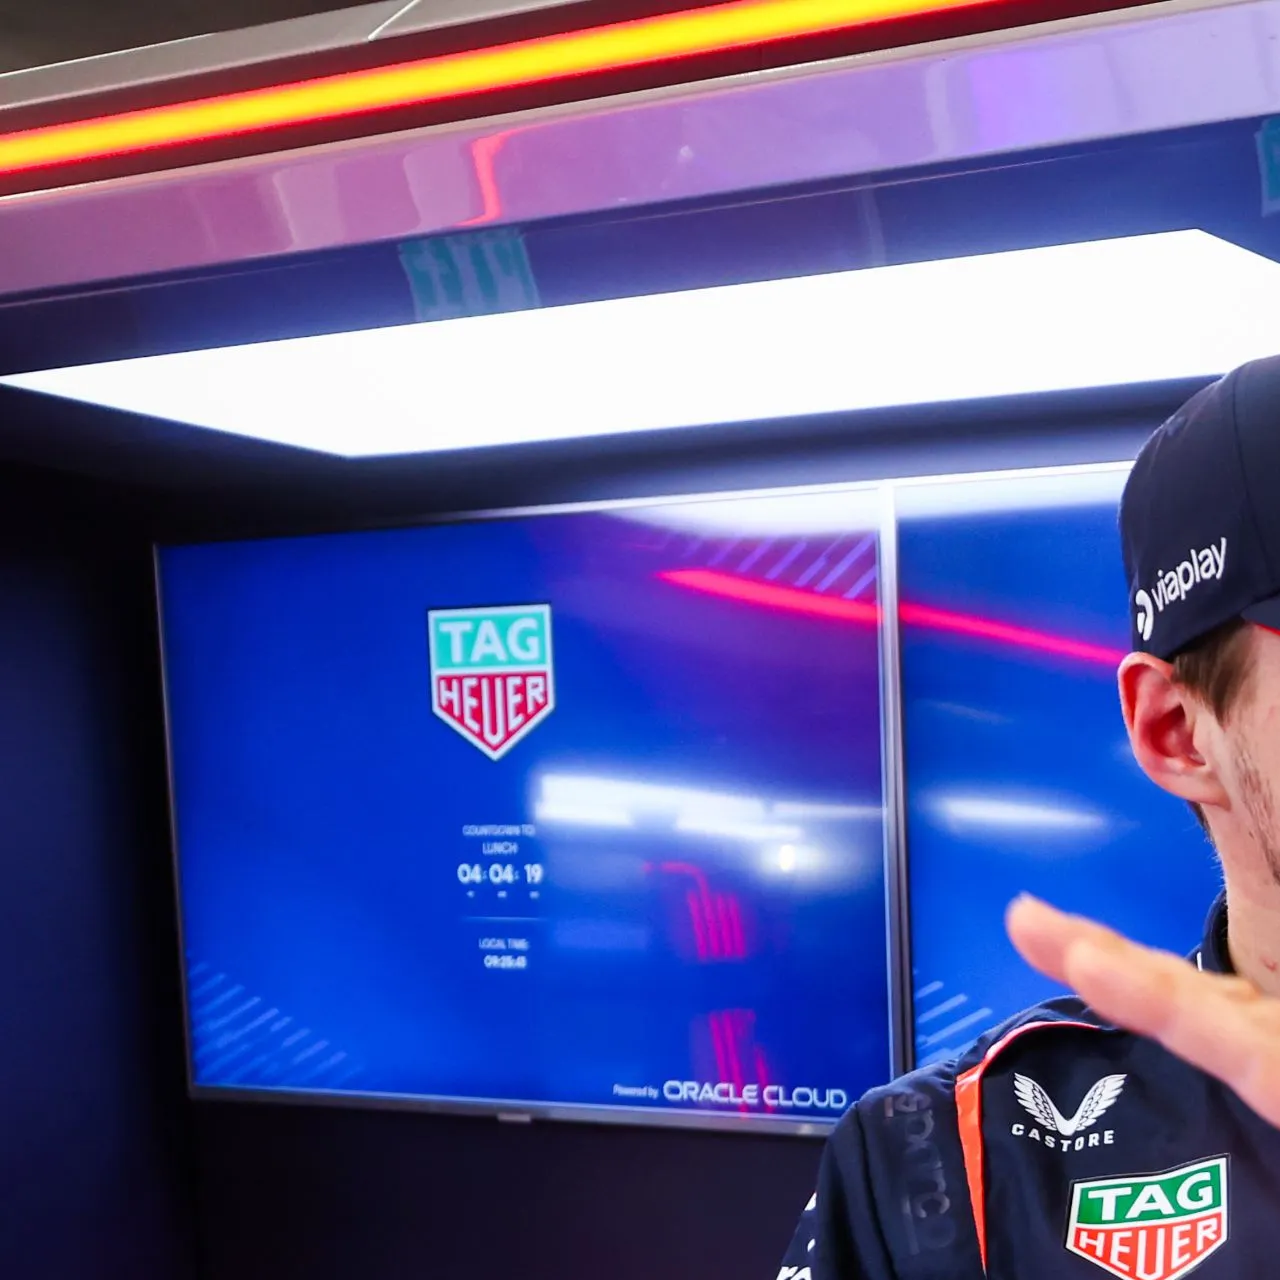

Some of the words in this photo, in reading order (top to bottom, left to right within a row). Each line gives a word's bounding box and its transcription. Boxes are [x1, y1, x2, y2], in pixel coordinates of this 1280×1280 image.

[1151, 536, 1227, 612] viaplay
[438, 617, 541, 664] TAG
[438, 675, 546, 746] HEUER
[482, 841, 519, 855] LUNCH
[612, 1083, 647, 1097] Powered
[648, 1085, 659, 1099] by
[662, 1079, 758, 1105] ORACLE
[763, 1085, 847, 1109] CLOUD
[1011, 1122, 1115, 1152] CASTORE
[1087, 1171, 1214, 1221] TAG
